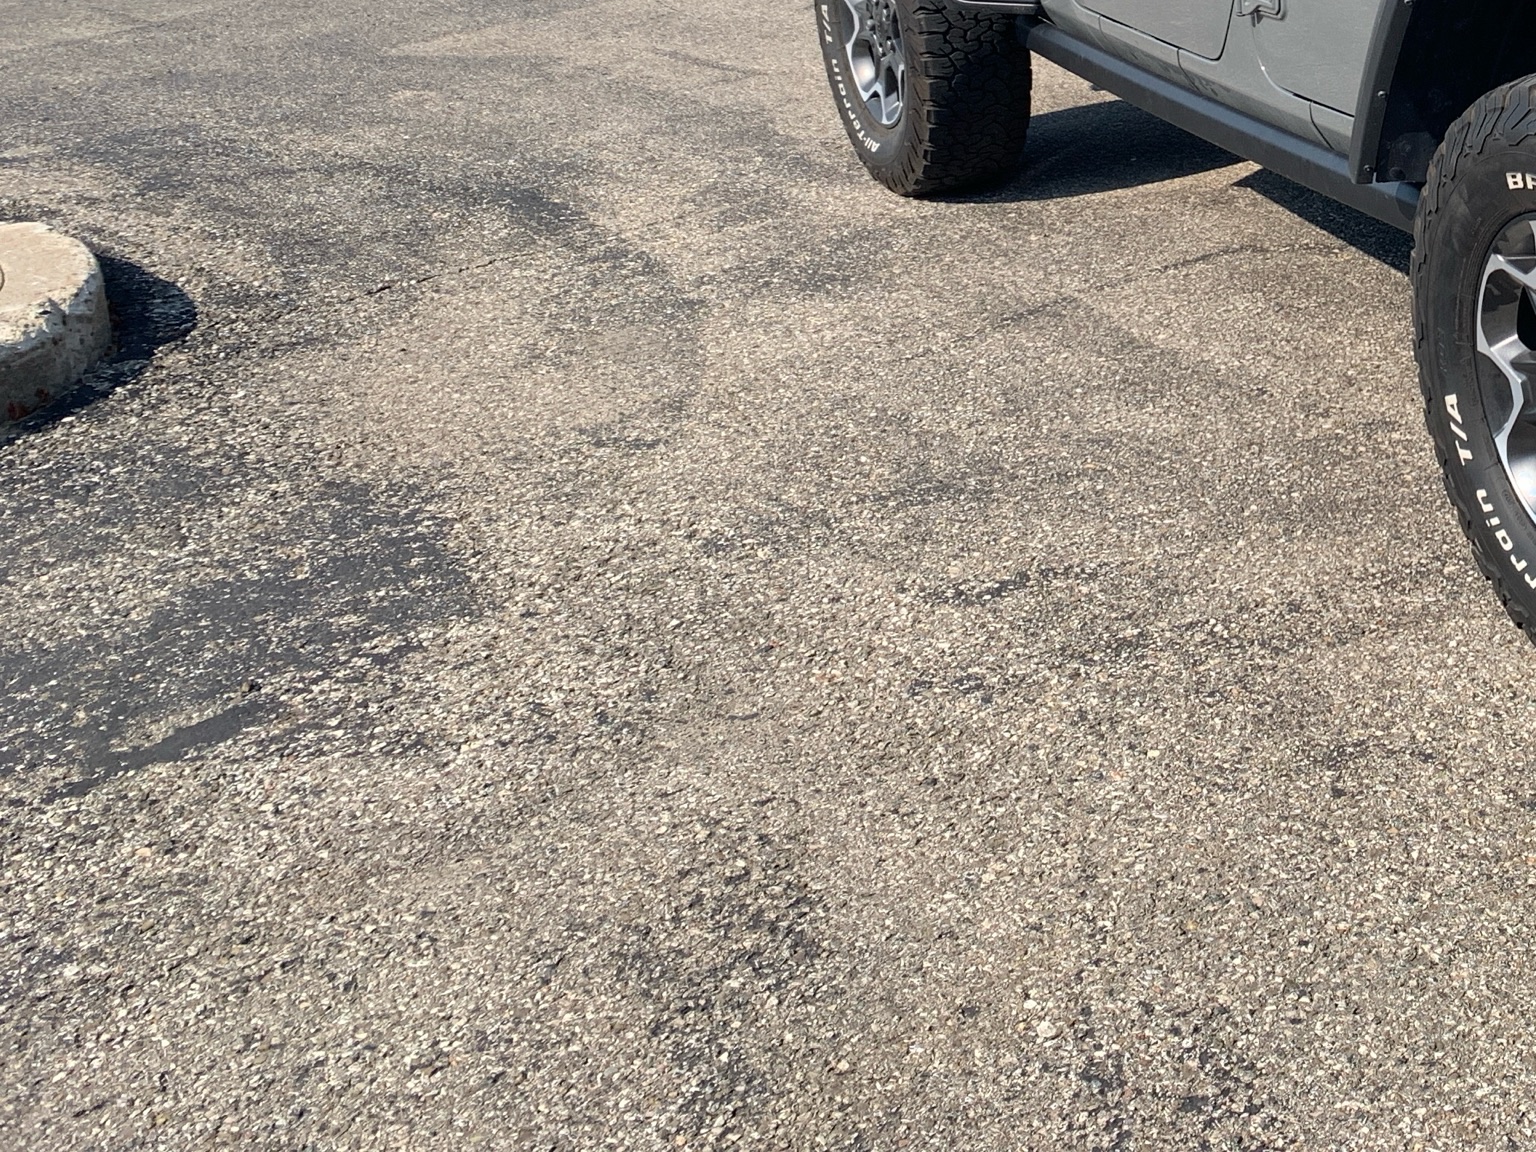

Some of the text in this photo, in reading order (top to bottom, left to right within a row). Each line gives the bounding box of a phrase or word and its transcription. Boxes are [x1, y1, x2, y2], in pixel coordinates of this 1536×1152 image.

[820, 4, 881, 153] All-Terrain T/A
[1444, 393, 1473, 466] T/A
